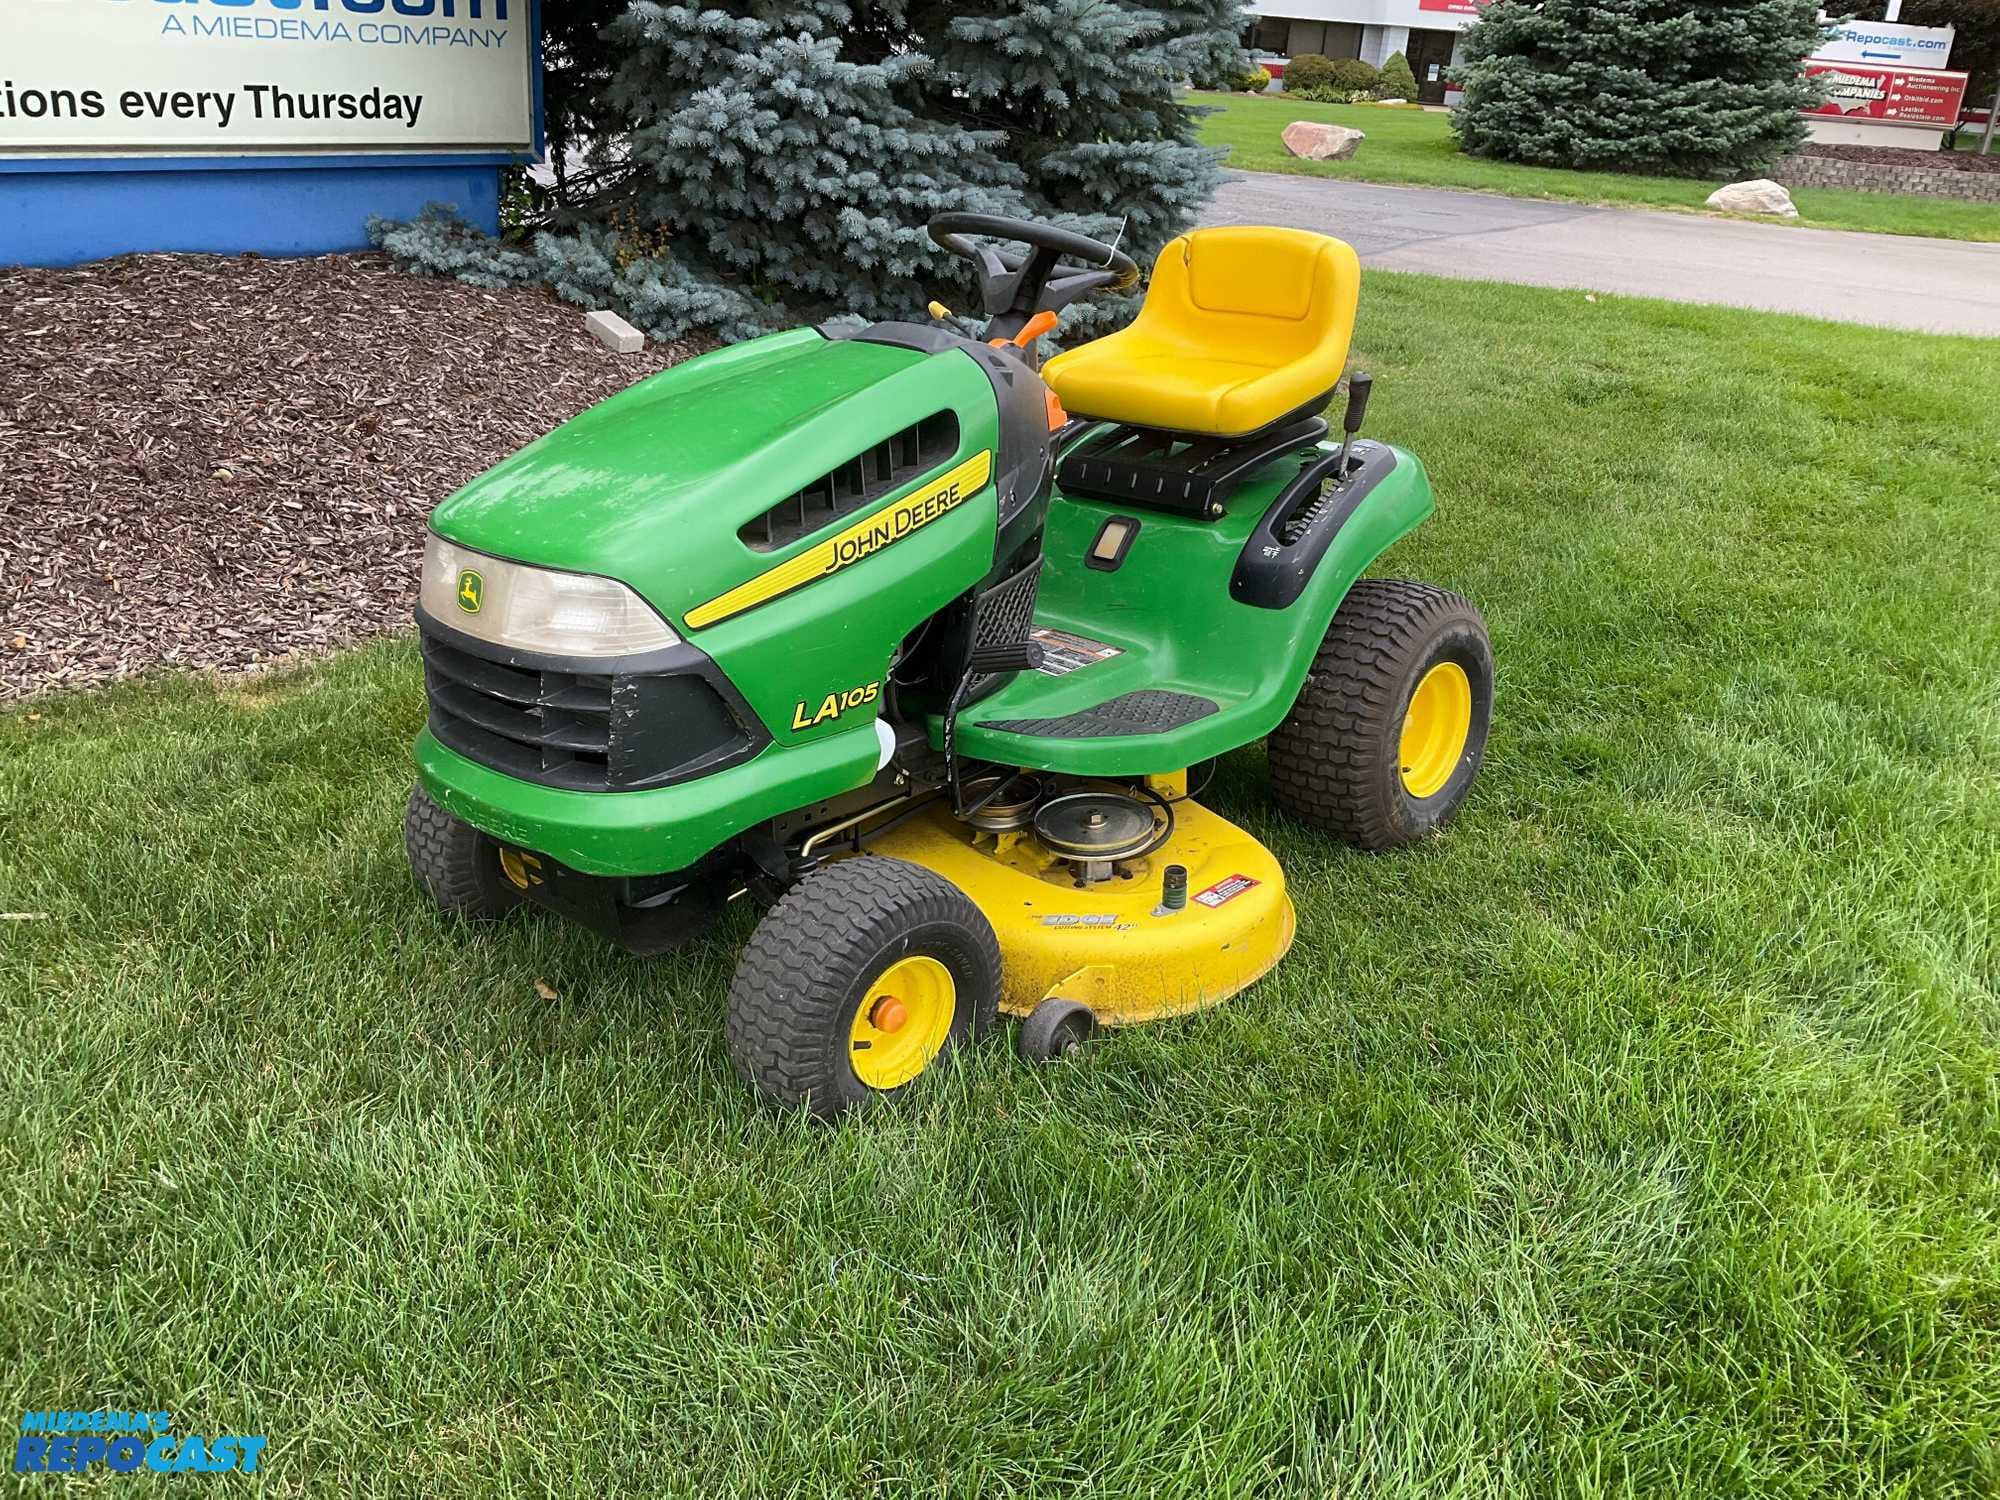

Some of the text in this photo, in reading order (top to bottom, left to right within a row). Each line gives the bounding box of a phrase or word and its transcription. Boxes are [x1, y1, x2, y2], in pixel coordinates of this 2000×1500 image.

[161, 15, 508, 49] A MIEDEMA COMPANY
[1846, 31, 1946, 50] Repocast.com
[0, 80, 423, 128] ions every Thursday
[825, 483, 961, 571] JOHN DEERE
[791, 682, 880, 731] LA105
